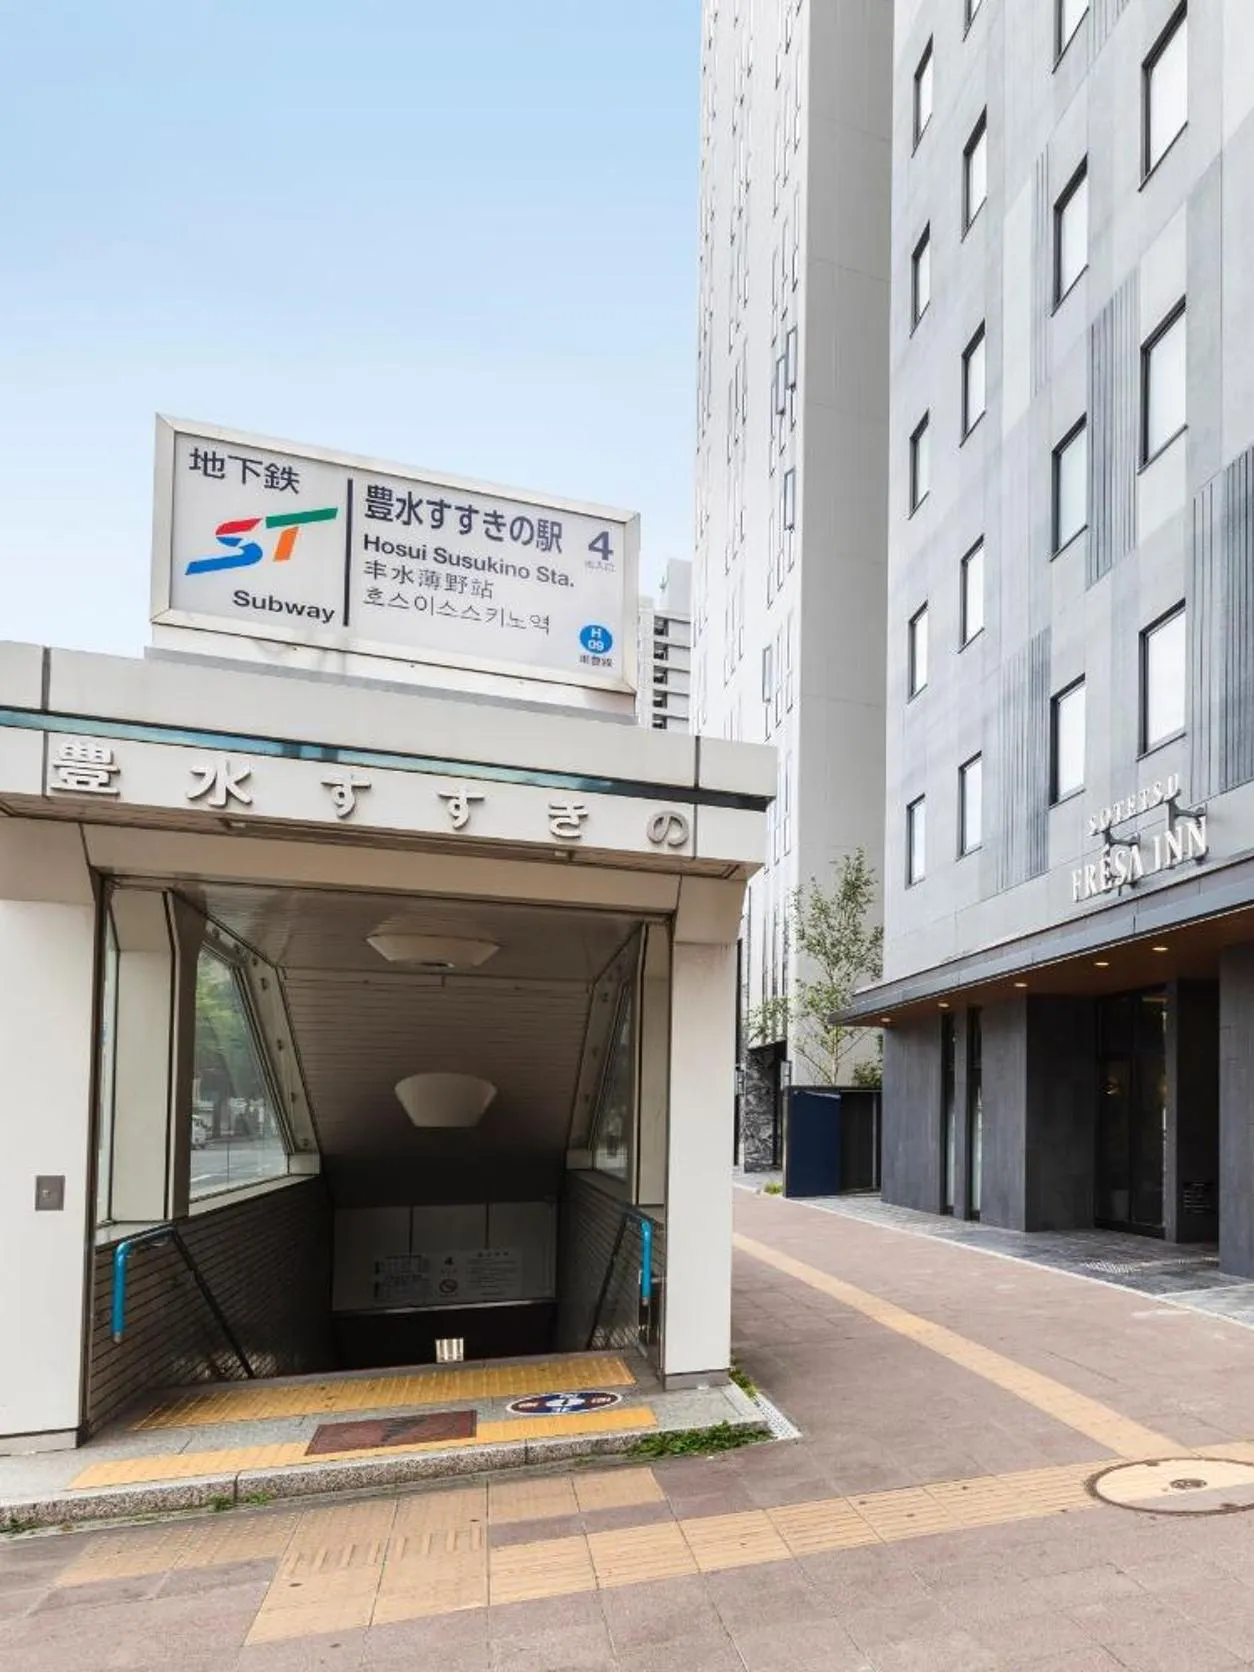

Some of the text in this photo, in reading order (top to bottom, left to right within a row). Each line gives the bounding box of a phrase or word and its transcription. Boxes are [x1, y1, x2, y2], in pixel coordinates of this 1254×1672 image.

[189, 448, 300, 494] 地下鉄
[365, 484, 563, 554] 豊水すすきの駅
[363, 533, 427, 561] Hosui
[433, 547, 530, 579] Susukino
[536, 566, 575, 588] Sta.
[588, 531, 614, 561] 4
[232, 590, 335, 624] Subway
[588, 639, 604, 651] 09
[591, 628, 602, 638] H
[50, 740, 690, 847] 豊水すすきの
[1088, 773, 1180, 834] SOTETSU
[1072, 815, 1207, 902] FRESA INN
